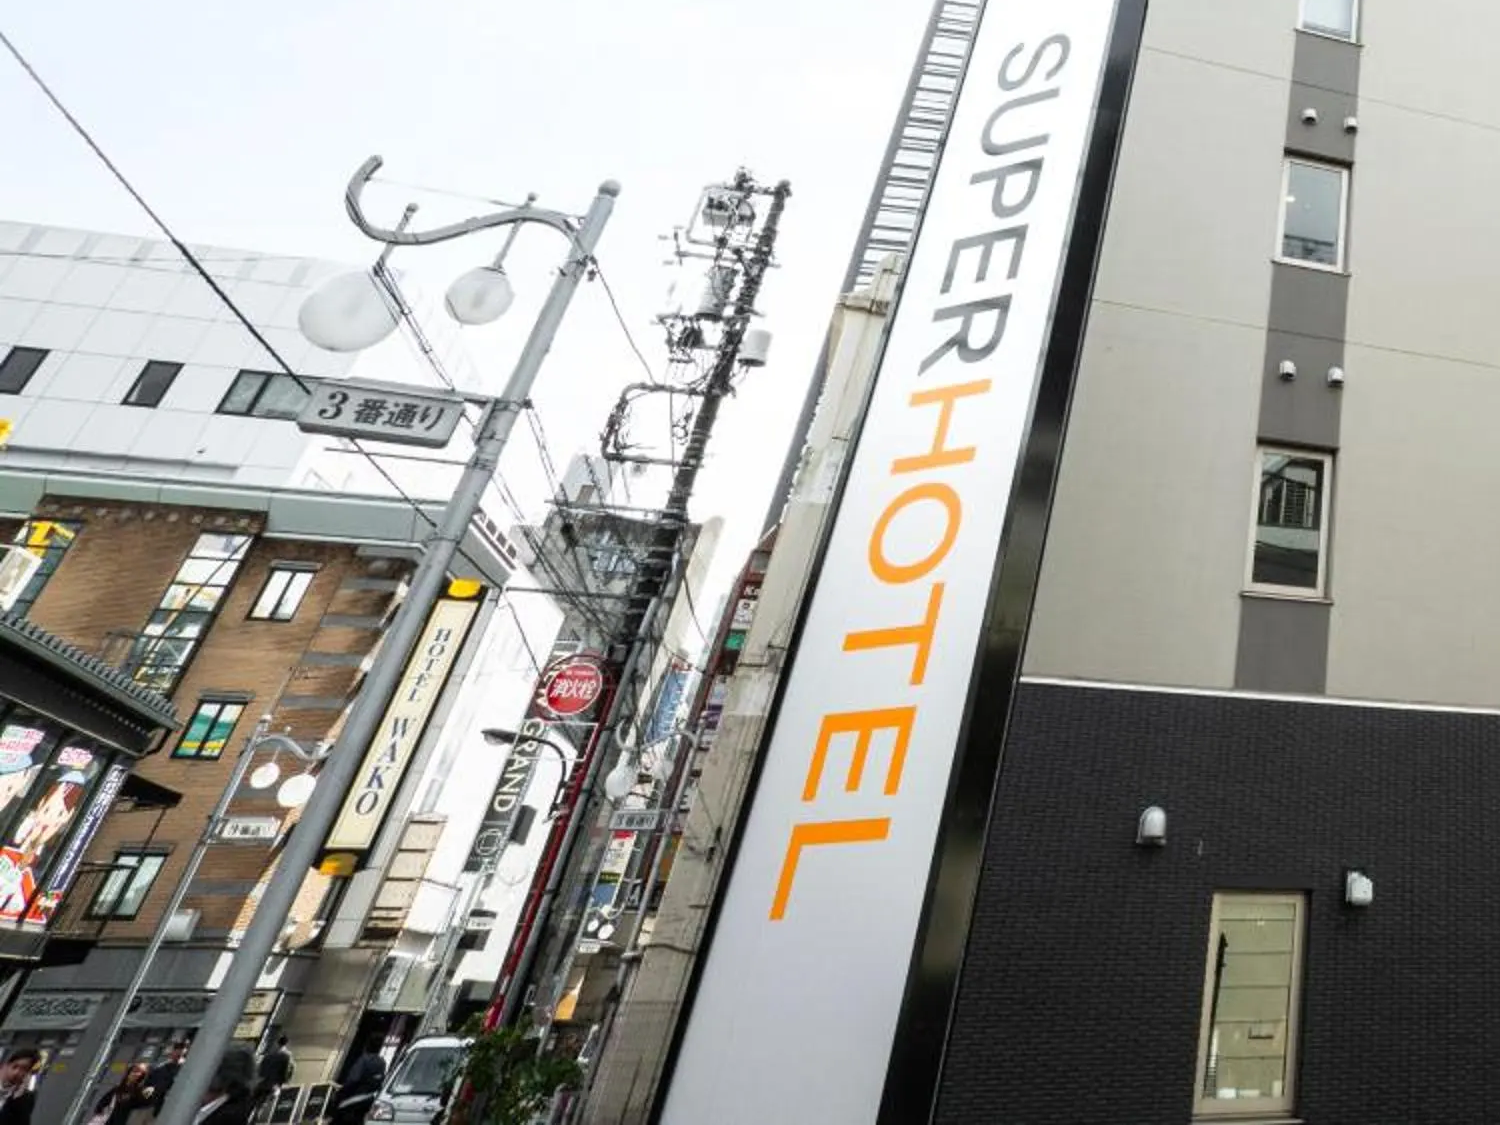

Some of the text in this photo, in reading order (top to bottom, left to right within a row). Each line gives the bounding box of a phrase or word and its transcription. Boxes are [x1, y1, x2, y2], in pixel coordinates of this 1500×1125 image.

[317, 390, 446, 432] 3番通り
[354, 628, 453, 817] HOTEL WAKO
[549, 677, 598, 700] 消火栓
[493, 718, 545, 813] GRAND
